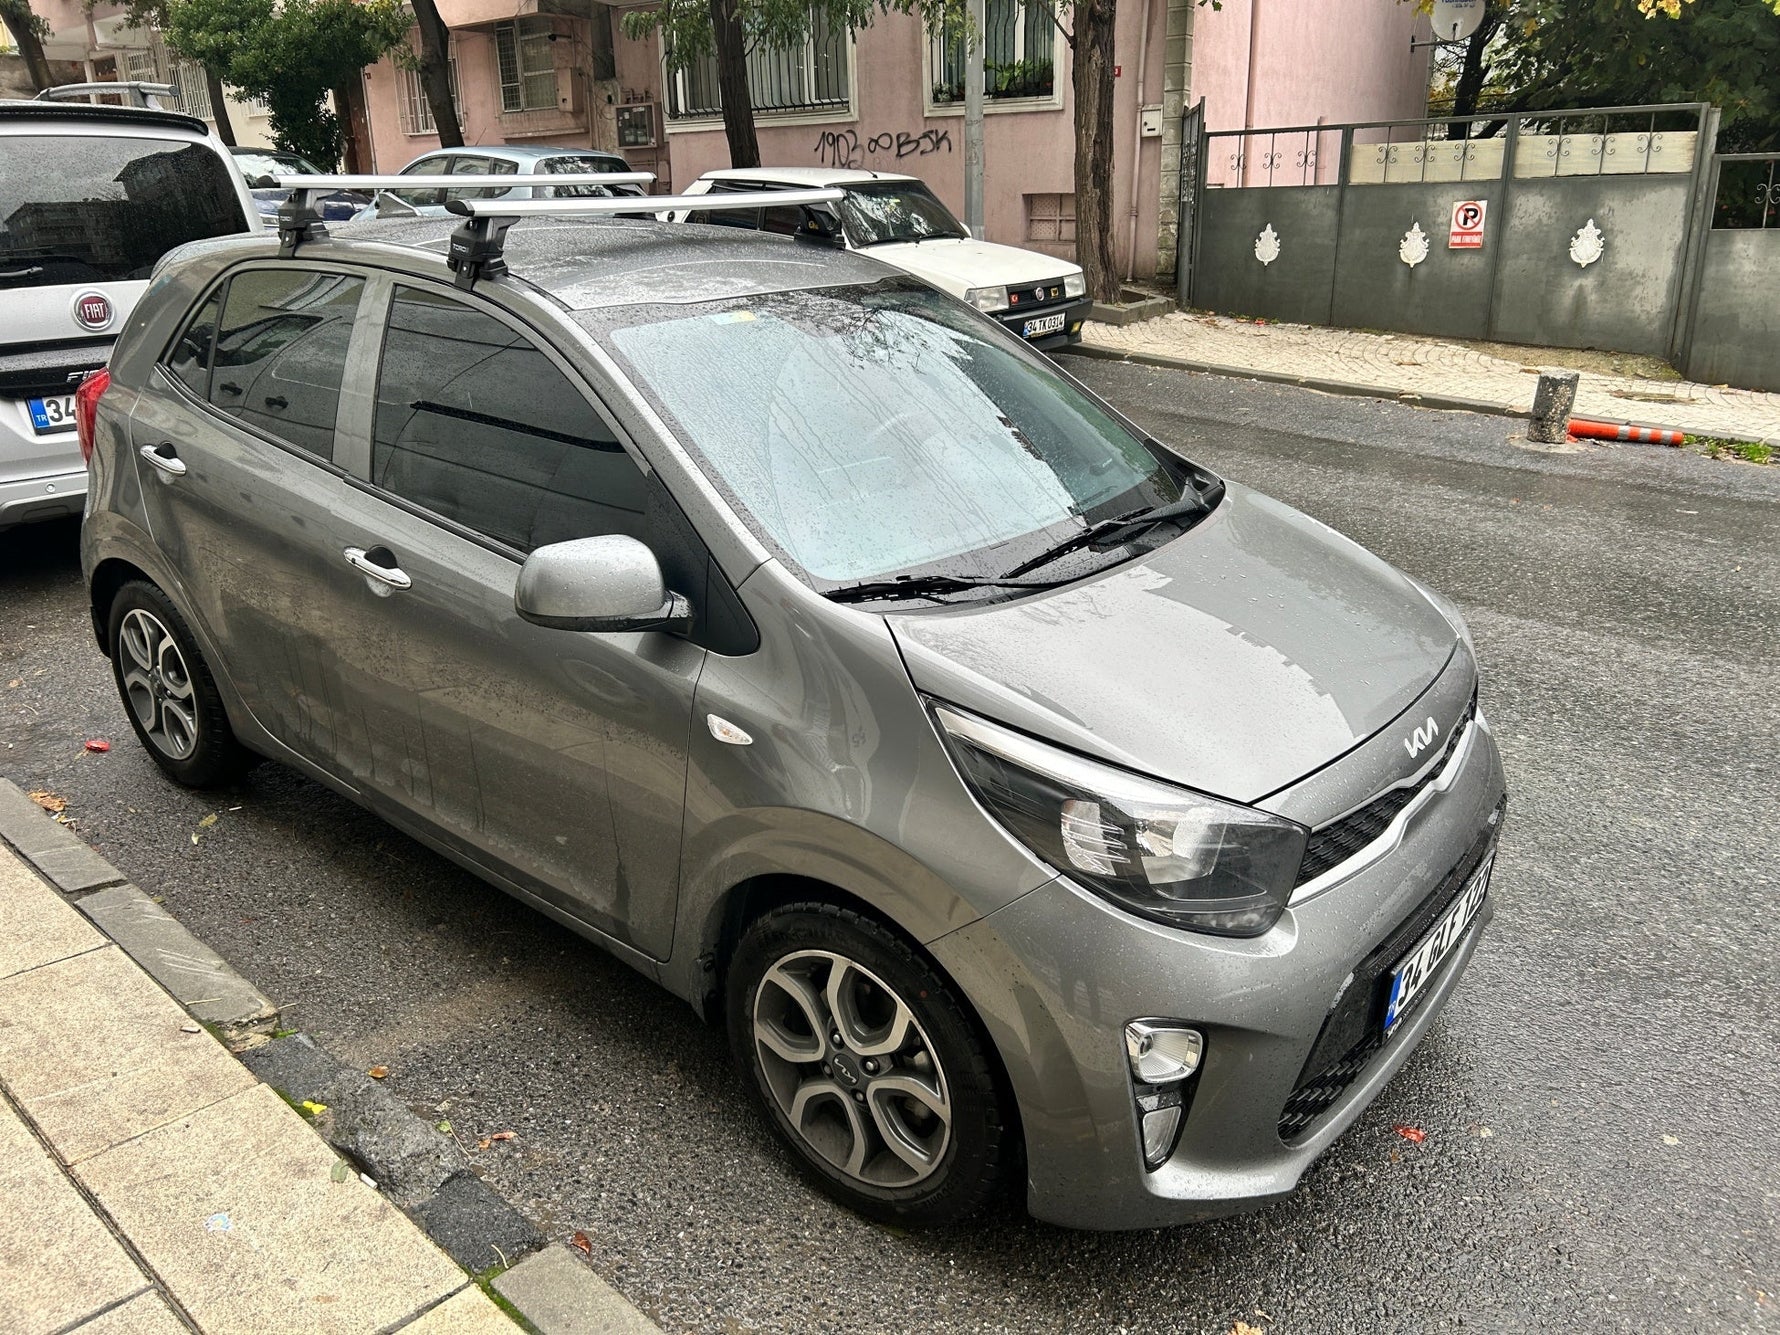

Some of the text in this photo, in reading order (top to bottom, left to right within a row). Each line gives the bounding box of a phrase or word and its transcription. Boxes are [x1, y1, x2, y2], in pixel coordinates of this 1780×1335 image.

[814, 129, 865, 169] 1903
[1463, 207, 1479, 226] P
[84, 303, 104, 319] FIAT
[1028, 321, 1037, 333] 34
[1038, 318, 1048, 331] TK
[36, 397, 76, 423] TR 34
[1398, 951, 1424, 1007] 34
[1426, 903, 1461, 973] GLF
